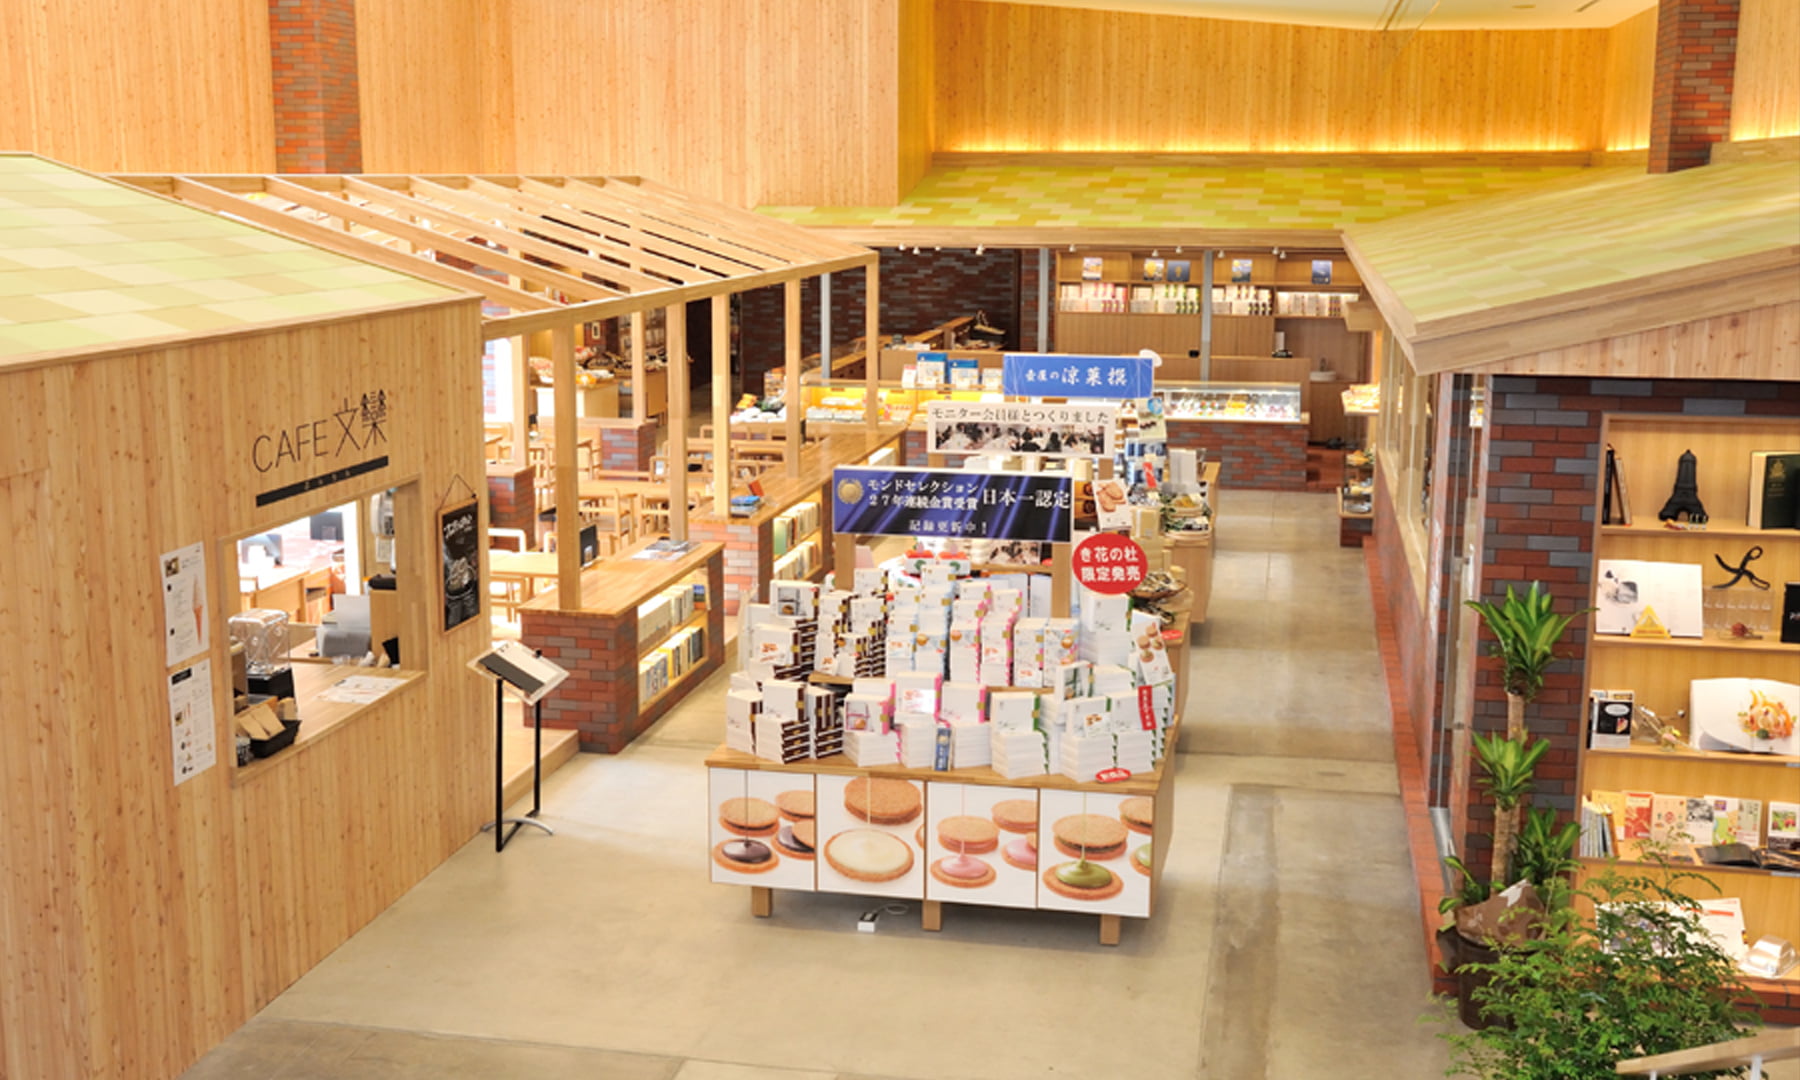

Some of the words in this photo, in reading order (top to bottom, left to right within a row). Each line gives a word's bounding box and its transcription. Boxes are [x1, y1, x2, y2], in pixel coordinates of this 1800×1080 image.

[932, 407, 1110, 425] モニター会員様とつくりました
[252, 419, 329, 473] CAFE
[868, 479, 979, 494] モンドセレクション
[983, 488, 1071, 509] 日本一認定
[1080, 545, 1139, 563] き花の杜
[1081, 565, 1141, 582] 限定発売
